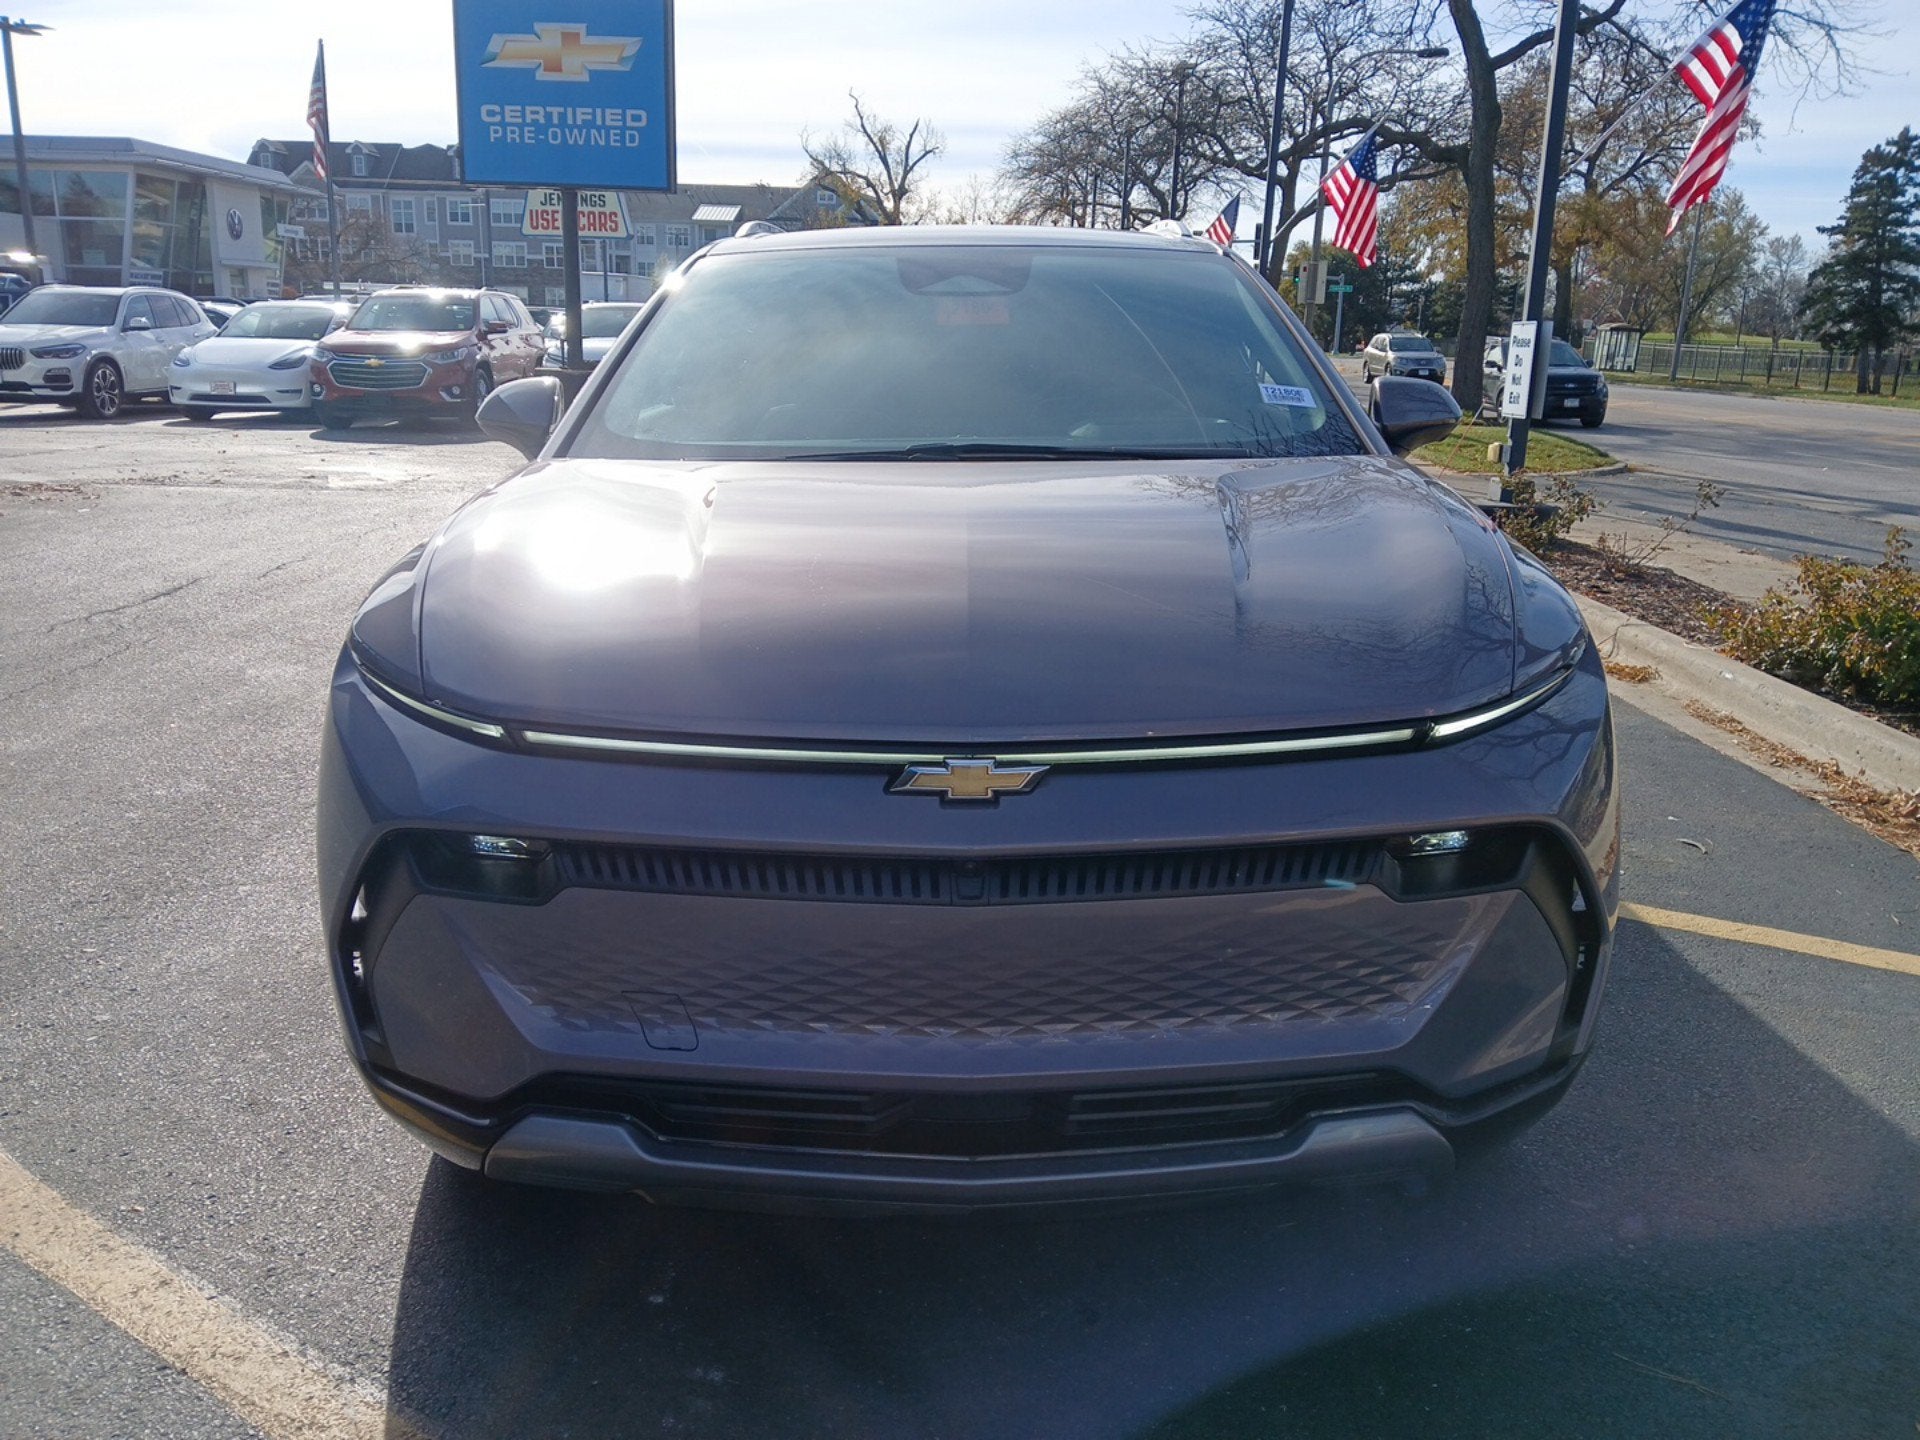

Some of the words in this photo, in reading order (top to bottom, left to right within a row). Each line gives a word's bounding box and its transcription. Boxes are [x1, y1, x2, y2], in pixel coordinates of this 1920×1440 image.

[480, 104, 648, 127] CERTIFIED
[489, 125, 640, 147] PRE-OWNED
[540, 192, 606, 208] JENNGS
[529, 209, 561, 231] USE
[577, 210, 619, 233] CARS
[1512, 335, 1531, 348] Please
[1514, 354, 1523, 367] Do
